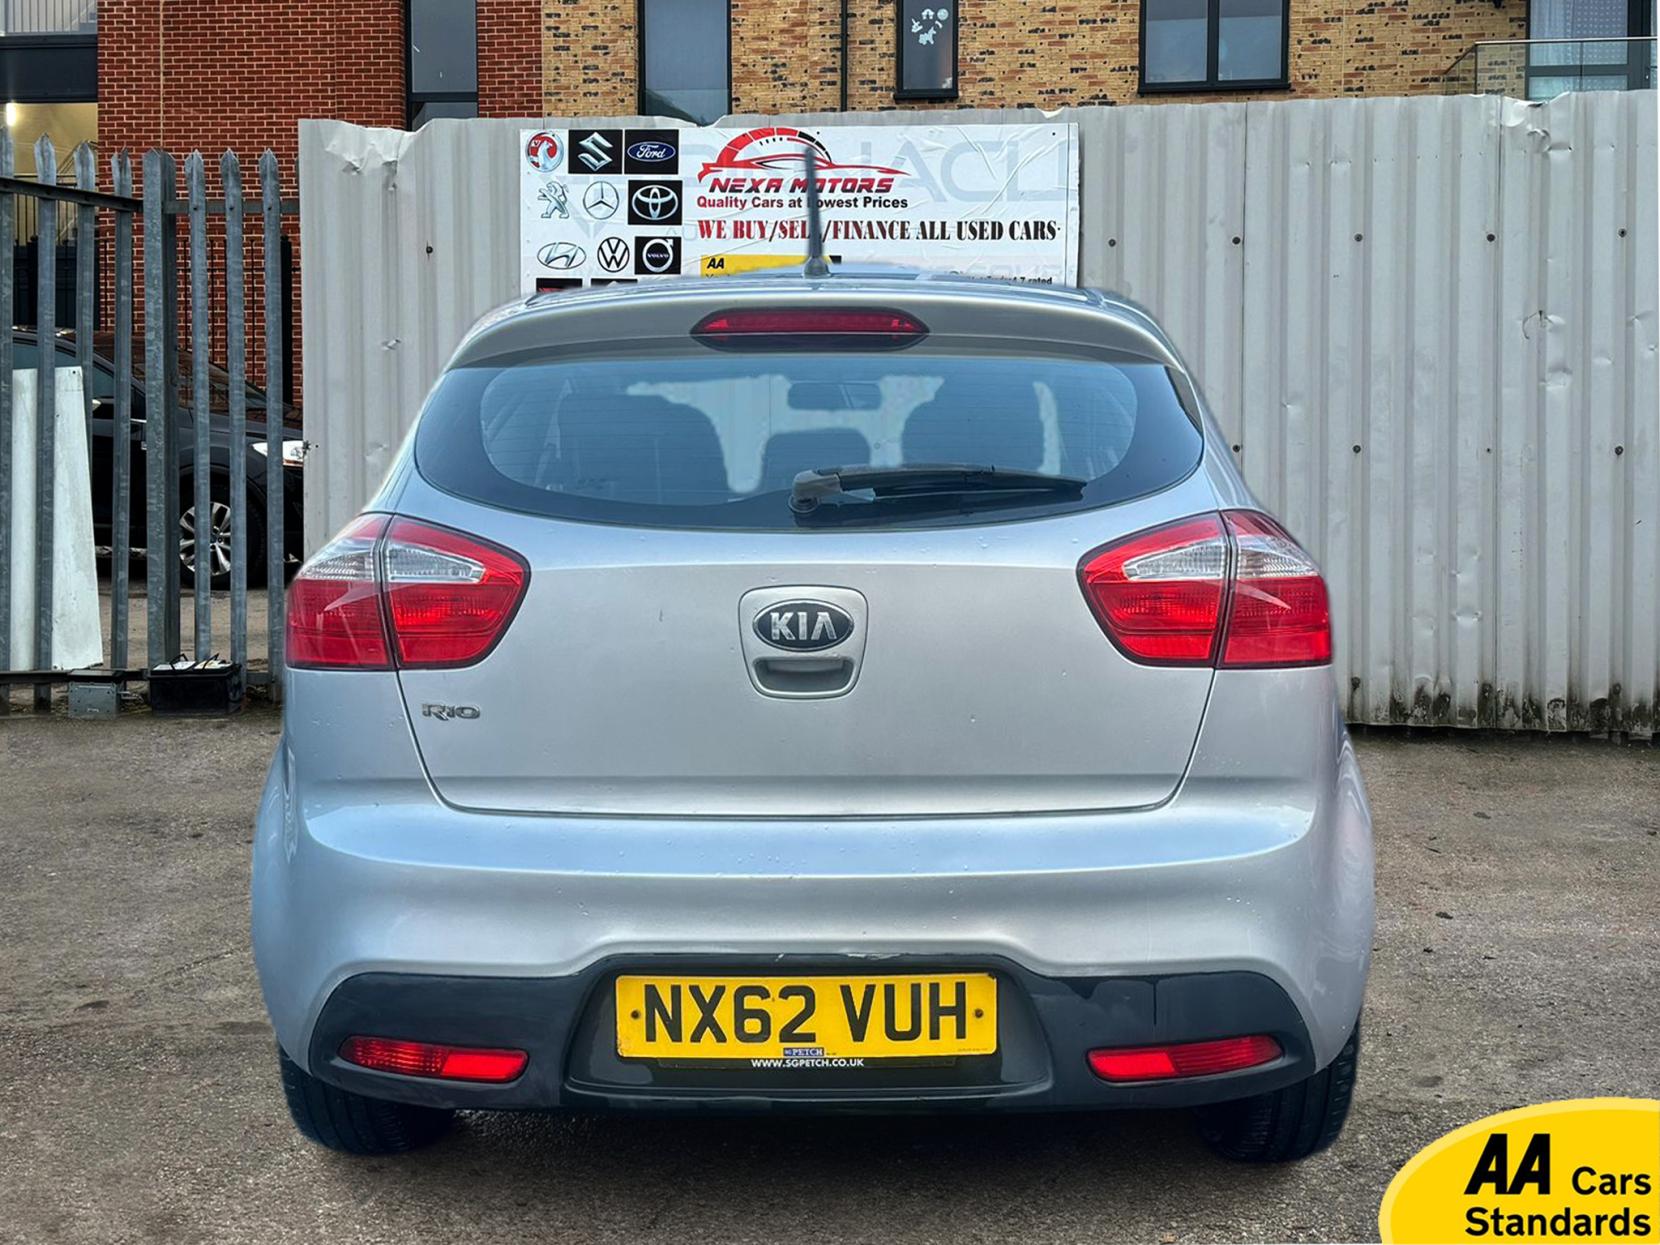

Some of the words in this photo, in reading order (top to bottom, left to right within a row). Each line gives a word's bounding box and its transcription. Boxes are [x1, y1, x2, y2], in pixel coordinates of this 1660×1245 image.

[636, 144, 666, 158] Ford
[709, 178, 784, 193] NEXA
[789, 178, 894, 193] MOTORS
[697, 196, 747, 210] Quality
[751, 196, 784, 208] Cars
[788, 197, 802, 208] at
[863, 196, 908, 208] Prices
[698, 220, 726, 239] WE
[733, 219, 910, 243] BUY/SEL/FINANCE
[916, 220, 950, 240] ALL
[956, 220, 1003, 240] USED
[707, 258, 724, 268] AA
[770, 611, 837, 640] KIA
[422, 704, 480, 721] RIO
[644, 983, 817, 1043] NX62
[839, 981, 967, 1042] VUH
[751, 1058, 865, 1068] WWW.SGPETCH.CO.UK
